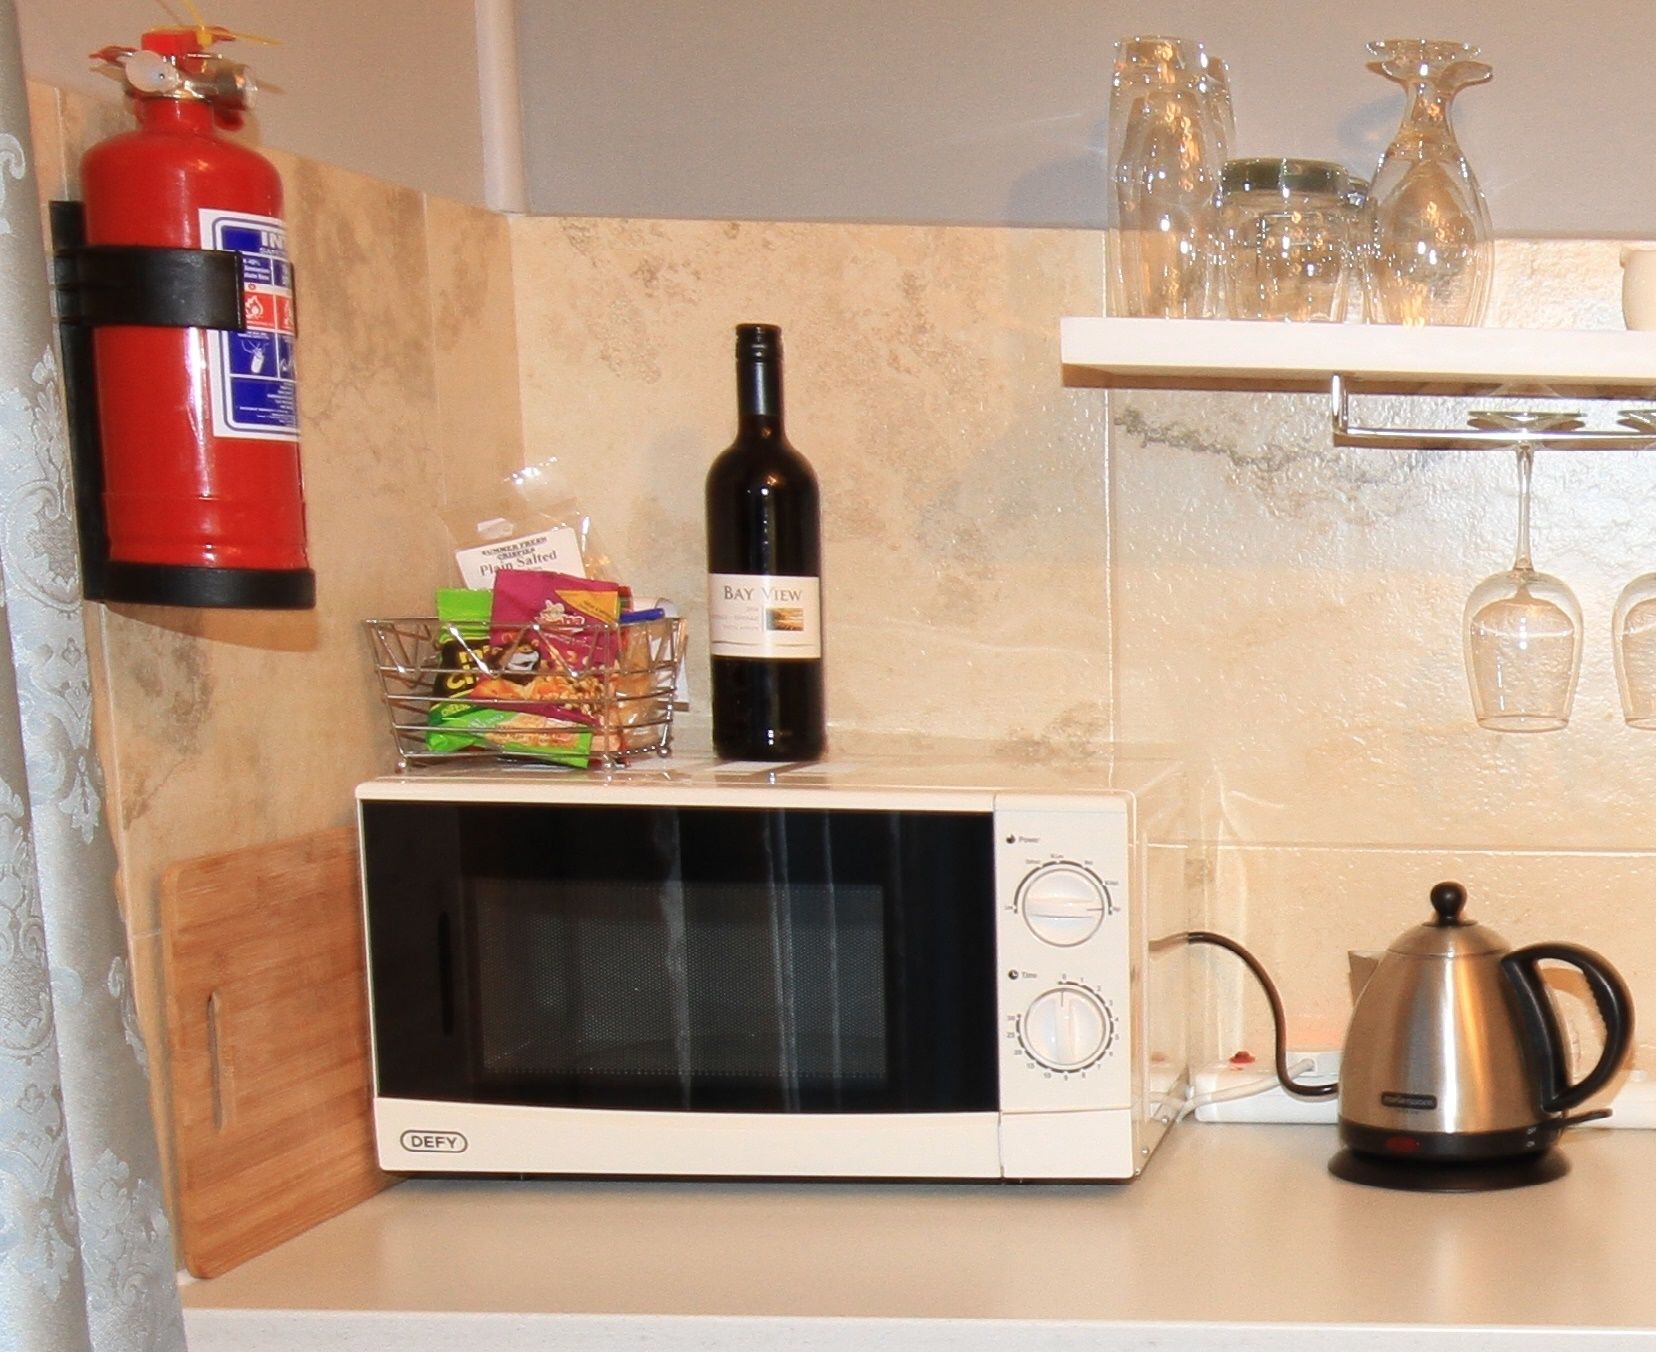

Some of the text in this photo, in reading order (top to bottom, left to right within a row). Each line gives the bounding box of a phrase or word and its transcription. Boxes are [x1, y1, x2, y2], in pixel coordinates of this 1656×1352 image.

[480, 559, 513, 576] Plain
[517, 550, 557, 567] Salted
[724, 585, 754, 600] BAY
[1018, 835, 1039, 844] Power
[1021, 971, 1037, 979] Time
[411, 1135, 457, 1148] DEFY
